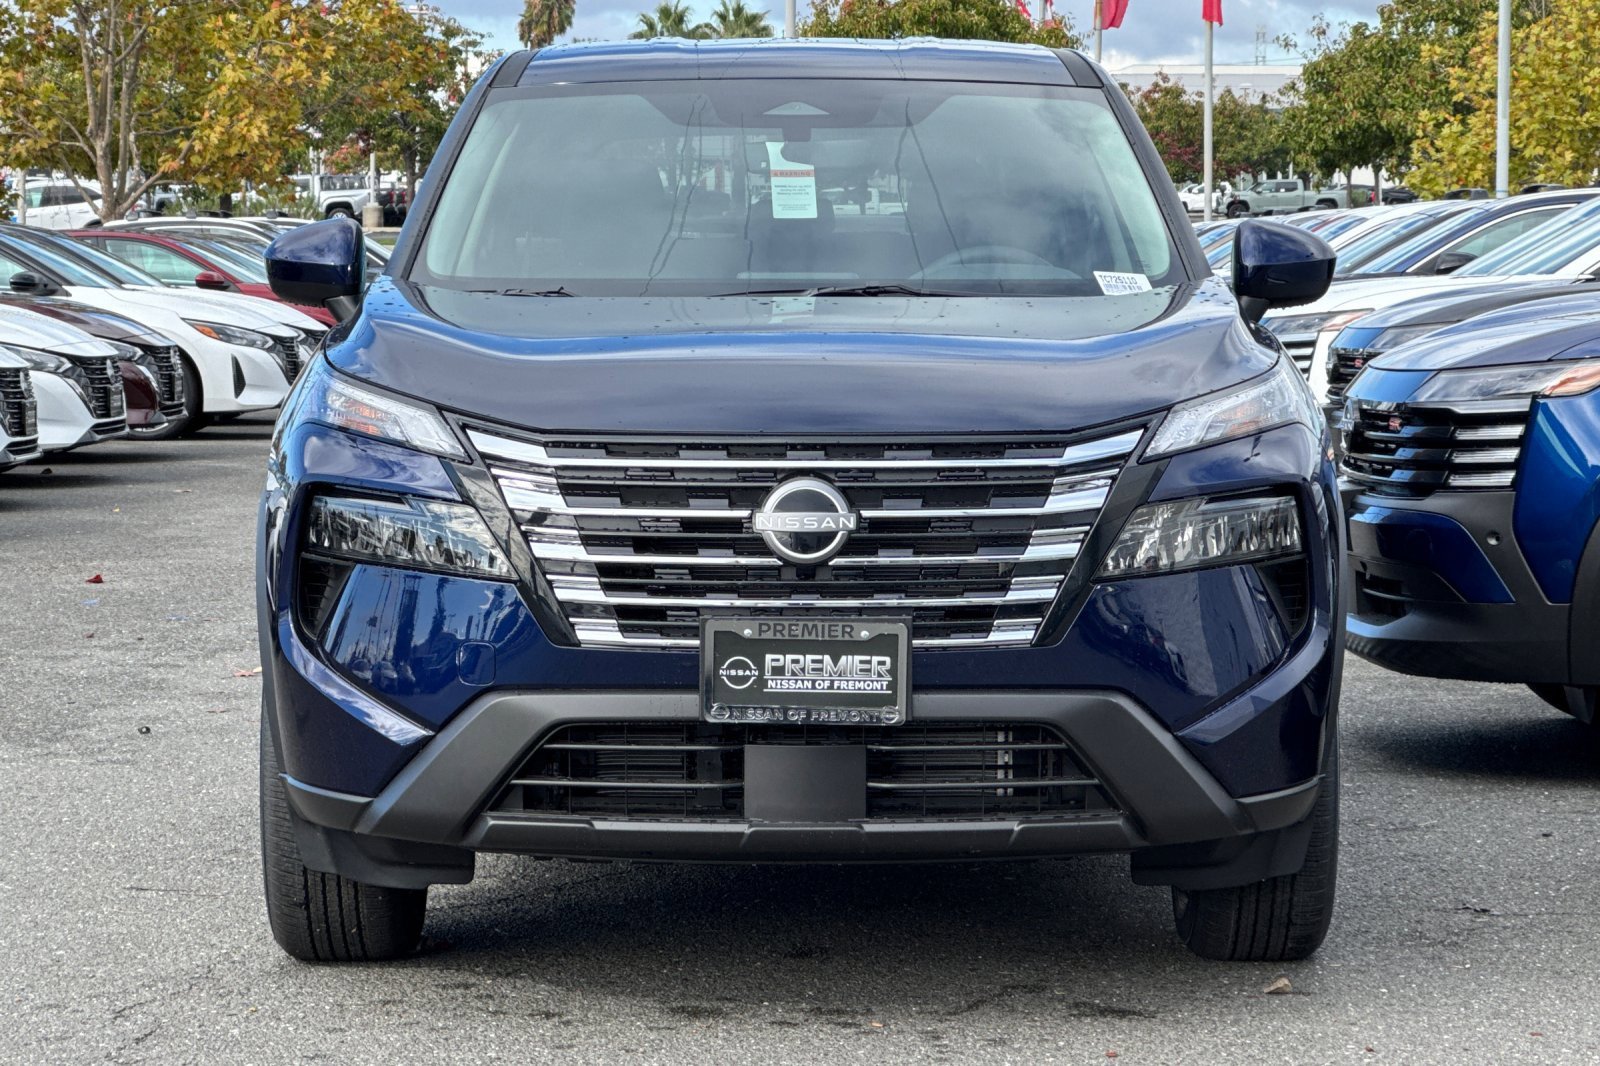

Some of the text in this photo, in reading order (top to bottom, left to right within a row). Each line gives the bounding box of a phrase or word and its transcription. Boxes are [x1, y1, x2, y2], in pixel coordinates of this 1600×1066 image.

[758, 516, 855, 529] NISSAN
[758, 622, 855, 639] PREMIER
[719, 668, 759, 676] NISSAN
[765, 653, 892, 678] PREMIER
[767, 679, 888, 691] NISSAN OF FREMONT
[731, 708, 879, 722] NISSAN OF FREMONT
